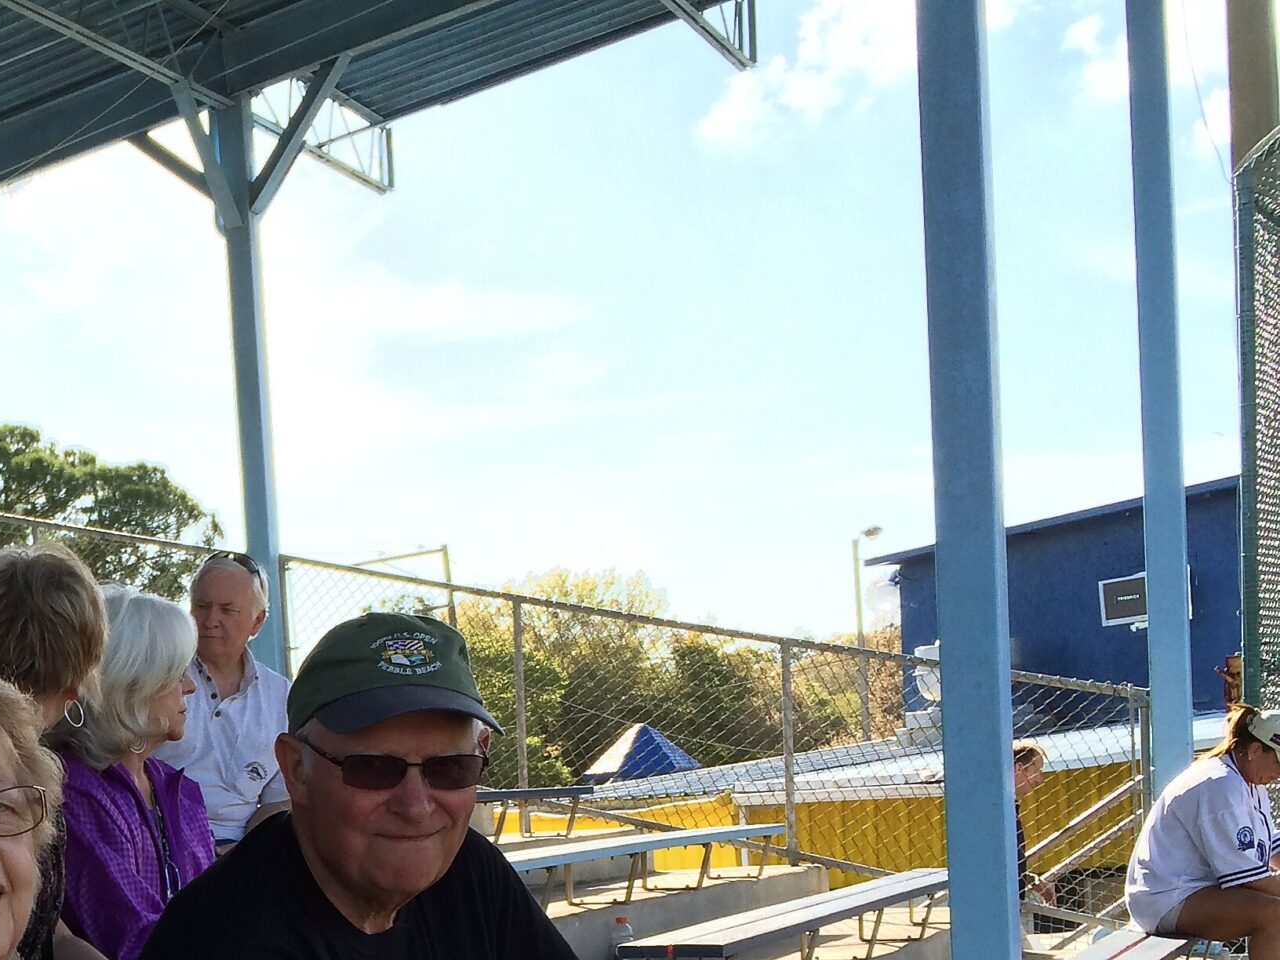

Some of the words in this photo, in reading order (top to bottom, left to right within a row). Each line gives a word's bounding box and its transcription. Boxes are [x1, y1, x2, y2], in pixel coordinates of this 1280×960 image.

[413, 632, 438, 645] OPEN
[377, 661, 413, 675] PEBBLE
[414, 660, 443, 675] BEACH
